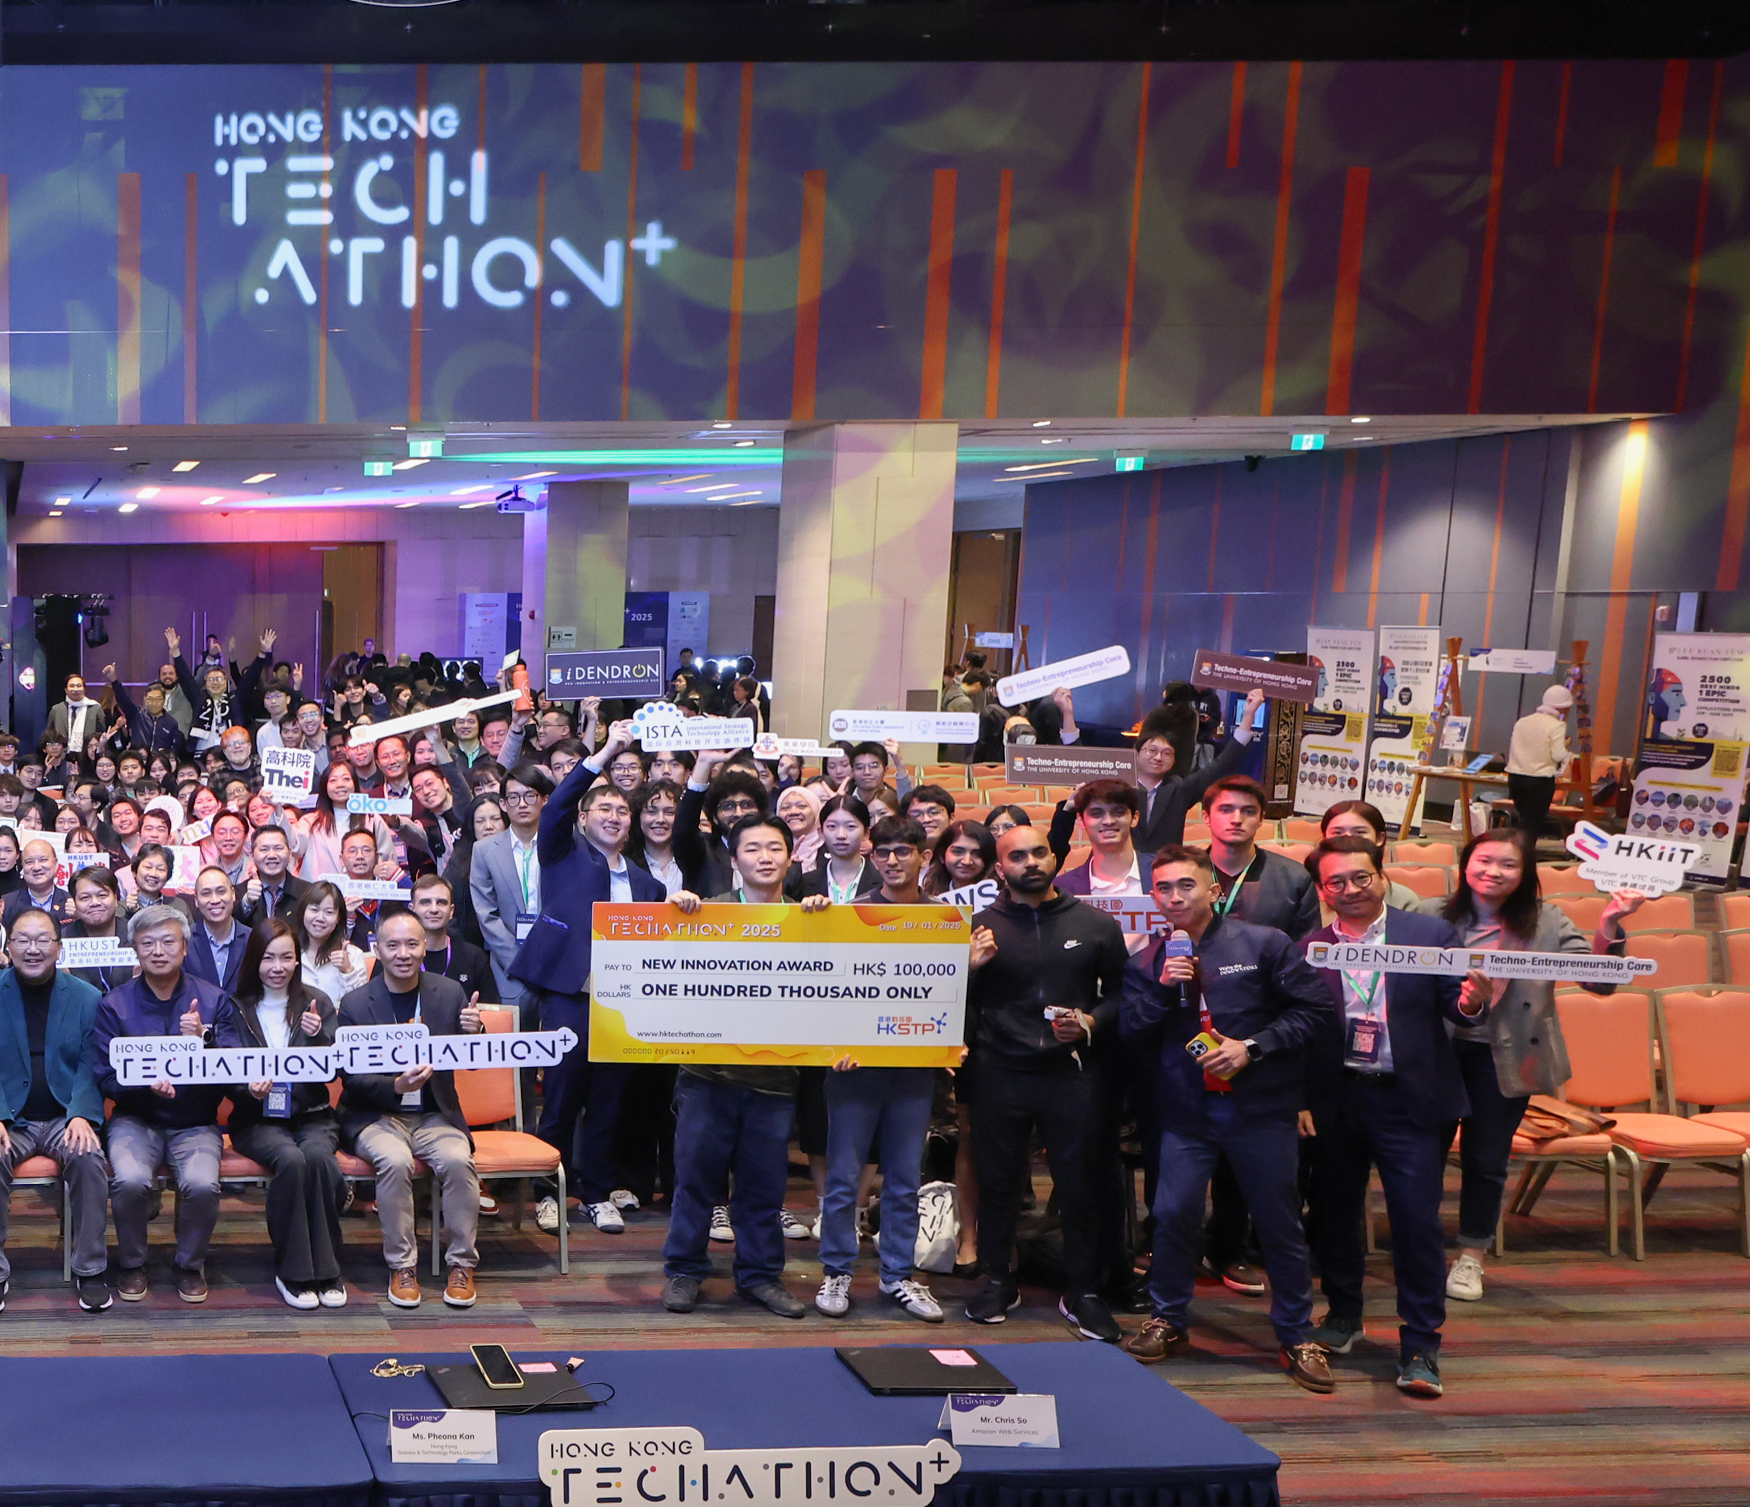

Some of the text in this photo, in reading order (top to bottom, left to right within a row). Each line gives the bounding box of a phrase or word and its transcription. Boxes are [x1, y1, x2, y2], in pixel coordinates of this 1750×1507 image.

[214, 106, 460, 147] HONG KONG
[214, 150, 489, 226] TECH
[631, 613, 653, 621] 2025
[1016, 654, 1122, 690] Techno-Entrepreneurship Core
[1214, 663, 1312, 686] Techno-Entrepreneurship Core
[1700, 675, 1731, 684] 2500
[646, 724, 683, 740] ISTA
[723, 728, 750, 736] Alliance
[724, 722, 748, 730] Strategic
[266, 750, 312, 768] 高科院
[1027, 757, 1132, 770] Techno-Entrepreneurship Core
[1039, 766, 1070, 774] UNIVERSITY
[350, 795, 387, 812] öko
[1585, 868, 1618, 877] Member
[1650, 876, 1675, 886] Group
[610, 920, 782, 938] TECHATHON+ 2025
[879, 923, 898, 932] Date
[69, 939, 118, 951] HKUST
[642, 959, 834, 972] NEW INNOVATION AWARD
[1489, 954, 1652, 972] Techno-Entrepreneurship Core
[853, 962, 956, 978] HK$ 100,000
[1488, 966, 1504, 974] THE
[1506, 967, 1553, 976] UNIVERSITY
[1570, 970, 1599, 978] HONG
[1602, 972, 1629, 980] KONG
[642, 984, 933, 1000] ONE HUNDRED THOUSAND ONLY
[637, 1031, 722, 1039] www.hktechathon.com
[877, 1023, 935, 1035] HKSTP
[342, 1030, 424, 1042] HONG KONG
[115, 1042, 197, 1054] HONG KONG
[980, 1416, 994, 1424] Mr.
[994, 1416, 1015, 1424] Chris
[428, 1432, 457, 1440] Pheona
[971, 1428, 1038, 1436] Amazon Web Services
[550, 1440, 693, 1458] HONG KONG
[551, 1451, 950, 1505] TECHATHON+
